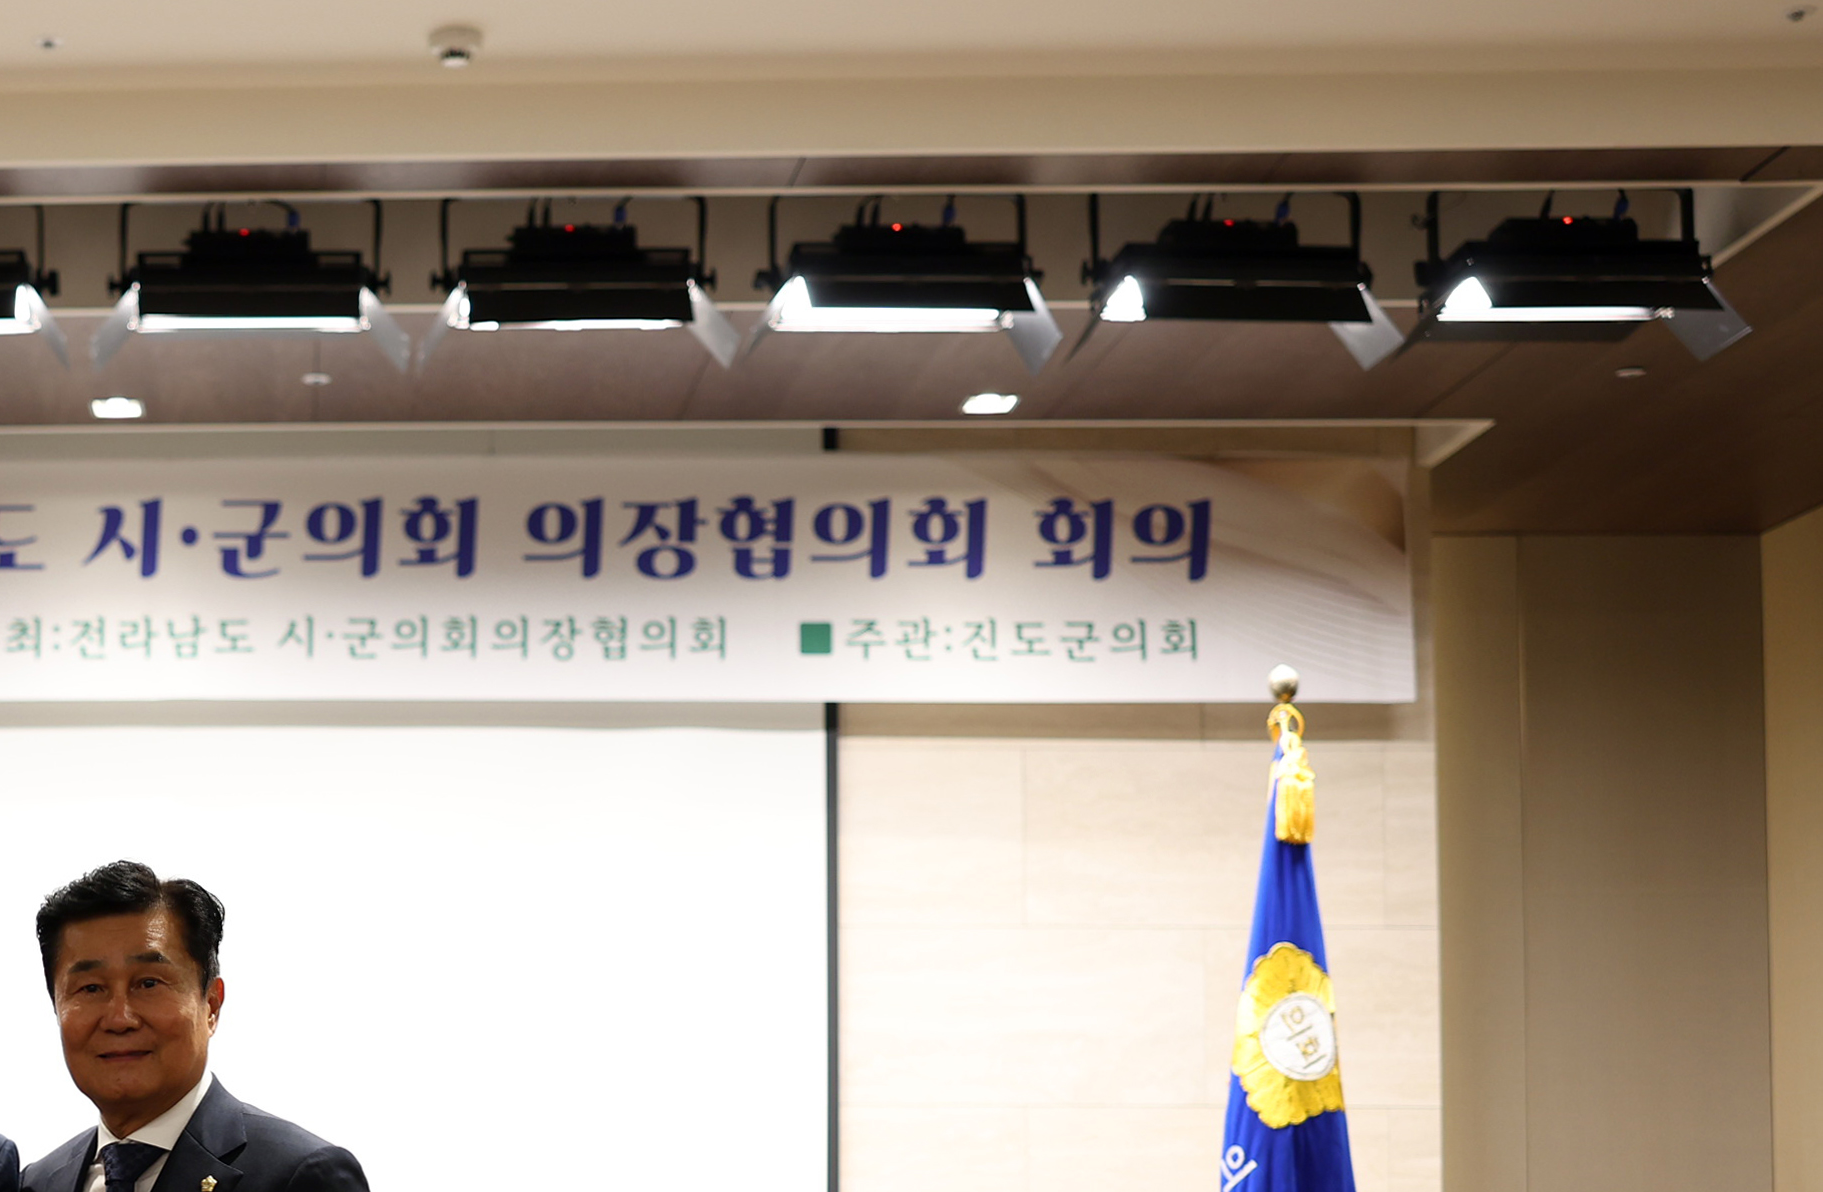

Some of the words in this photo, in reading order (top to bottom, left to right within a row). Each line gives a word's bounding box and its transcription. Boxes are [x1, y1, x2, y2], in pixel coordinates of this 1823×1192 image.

[81, 496, 479, 579] 시·군의회
[520, 496, 987, 580] 의장협의회
[1033, 496, 1212, 583] 회의
[277, 614, 727, 662] 시·군의회의장협의회
